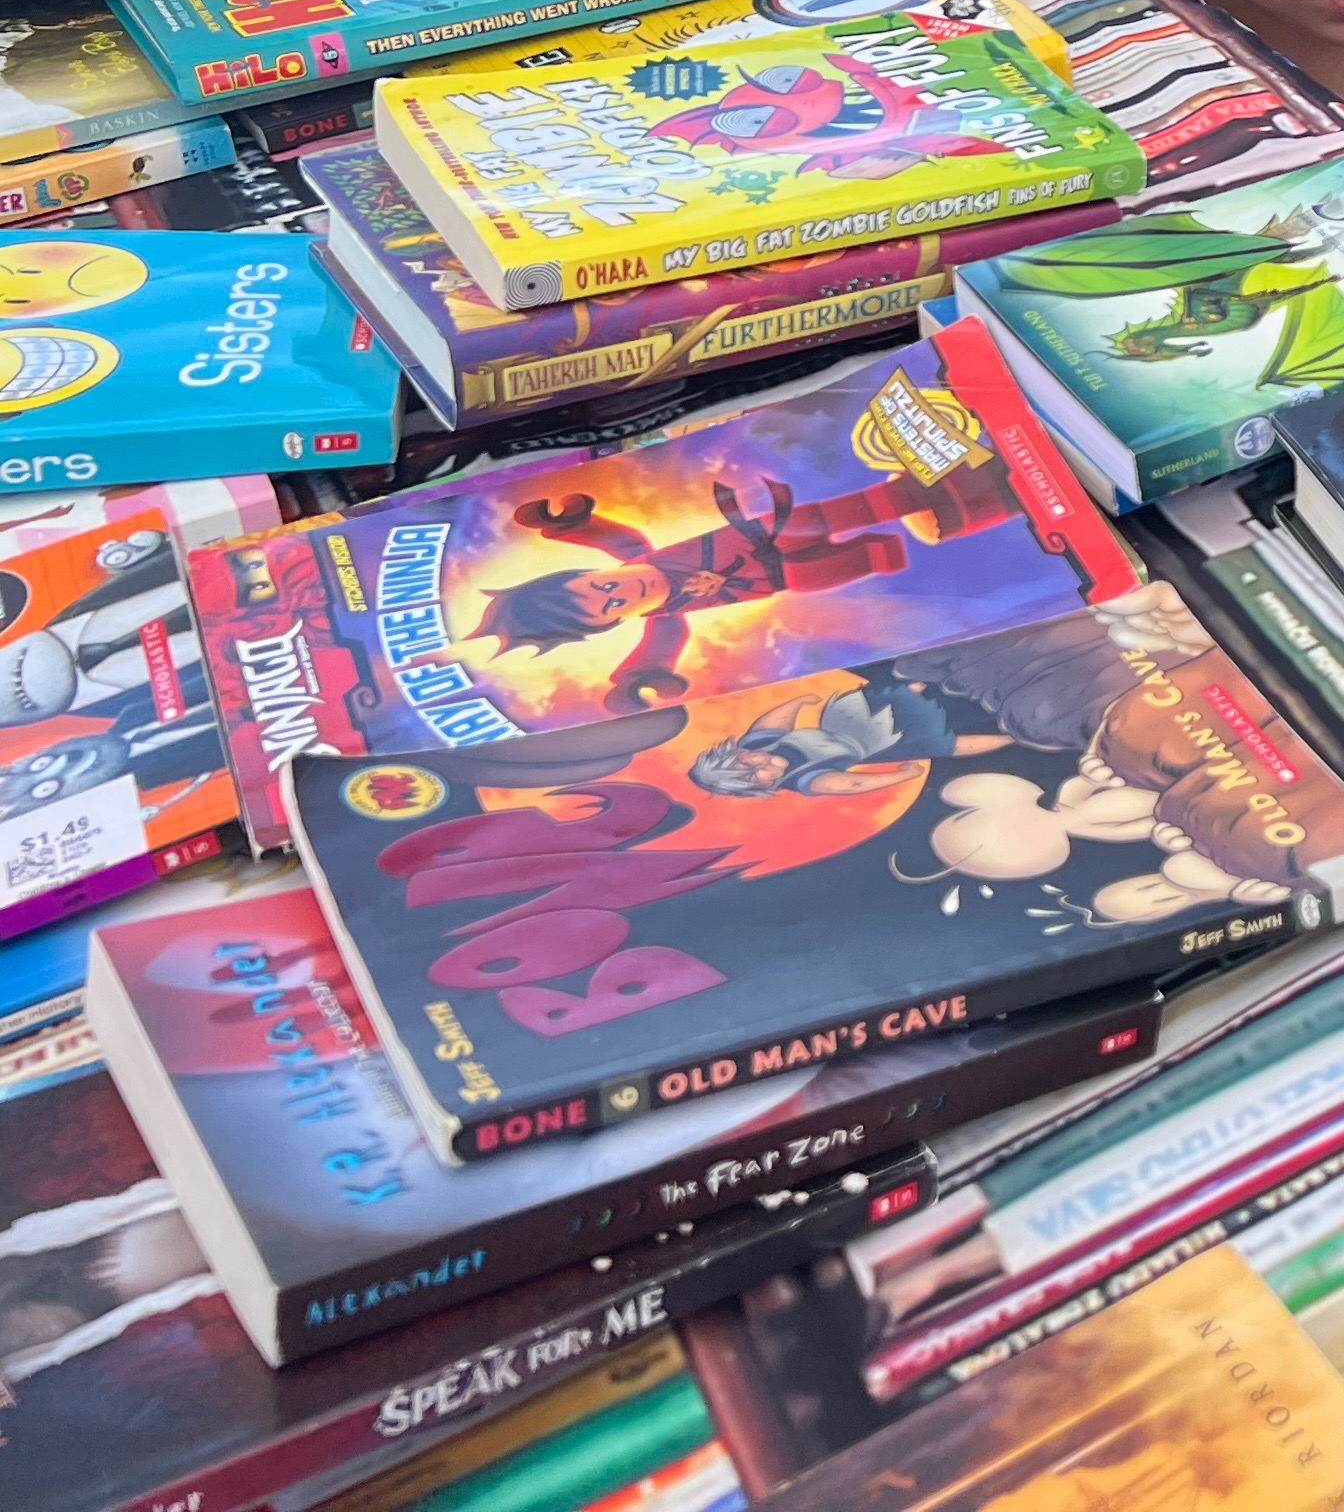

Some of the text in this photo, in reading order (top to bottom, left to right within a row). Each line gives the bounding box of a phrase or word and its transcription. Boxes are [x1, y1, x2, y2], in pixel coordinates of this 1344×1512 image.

[366, 34, 416, 57] THEN
[419, 10, 528, 49] EVERYTHING
[89, 109, 161, 136] BASKIN
[283, 115, 349, 142] BONE
[836, 24, 1068, 163] FINS FURY
[448, 86, 685, 227] ZOMBIE
[575, 172, 1095, 289] O'HARA MY BIG FAT ZOMBIE GOLDFISH FINS OF FURY
[179, 259, 291, 389] Sisters
[700, 284, 924, 353] FURTHERMORE
[506, 342, 658, 396] TAHEREH MAFI
[886, 372, 971, 466] SPINJITZU
[887, 407, 952, 476] MASTERS
[0, 448, 99, 482] ers
[1003, 426, 1061, 506] SCHOLASTIC
[1149, 446, 1221, 482] SUTHERLAND
[378, 522, 452, 597] NINJA
[142, 623, 175, 712] SCHOLASTIC
[378, 590, 450, 668] THE
[234, 616, 340, 774] NINJAGO
[1199, 686, 1291, 771] SCHOLASTIC
[1115, 647, 1315, 849] OLD MAN'S CAVE
[20, 816, 90, 854] $1.49
[1178, 912, 1285, 956] JEFF SMITH
[424, 999, 502, 1105] JEFF SMITH
[475, 994, 970, 1154] BONE OLD MAN'S CAVE
[706, 1118, 868, 1193] Fear Zone
[304, 1247, 489, 1328] Alexander
[374, 1288, 669, 1438] SPEAK FOR ME
[1195, 1315, 1324, 1471] RIORDAN
